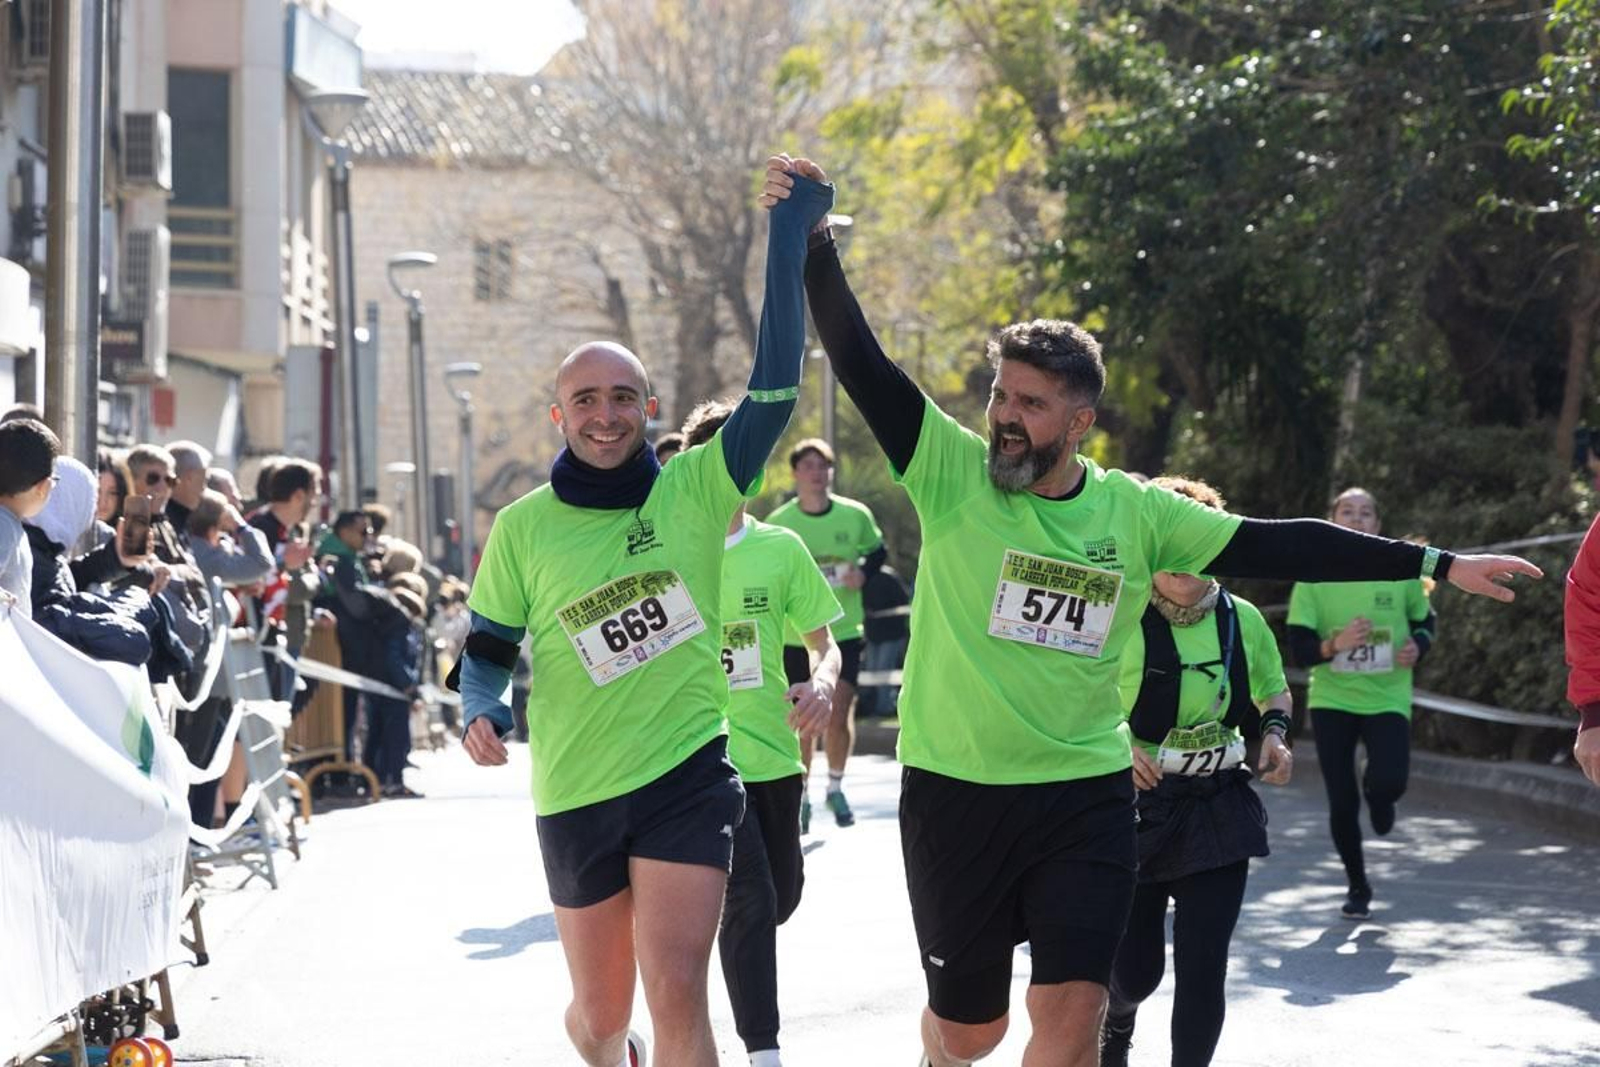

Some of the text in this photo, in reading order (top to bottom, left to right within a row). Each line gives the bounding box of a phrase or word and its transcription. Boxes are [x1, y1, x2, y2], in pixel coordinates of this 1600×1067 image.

[1019, 569, 1049, 586] CARRERA
[1049, 575, 1080, 590] POPULAR
[1027, 558, 1043, 571] SAN
[1043, 561, 1065, 575] JUAN
[1065, 565, 1088, 580] BOSCO
[579, 597, 596, 613] SAN
[596, 586, 616, 604] JUAN
[615, 576, 639, 593] BOSCO
[580, 603, 612, 625] CARRERA
[608, 587, 638, 611] POPULAR
[1021, 588, 1088, 632] 574
[600, 596, 669, 653] 669
[1180, 746, 1227, 776] 727
